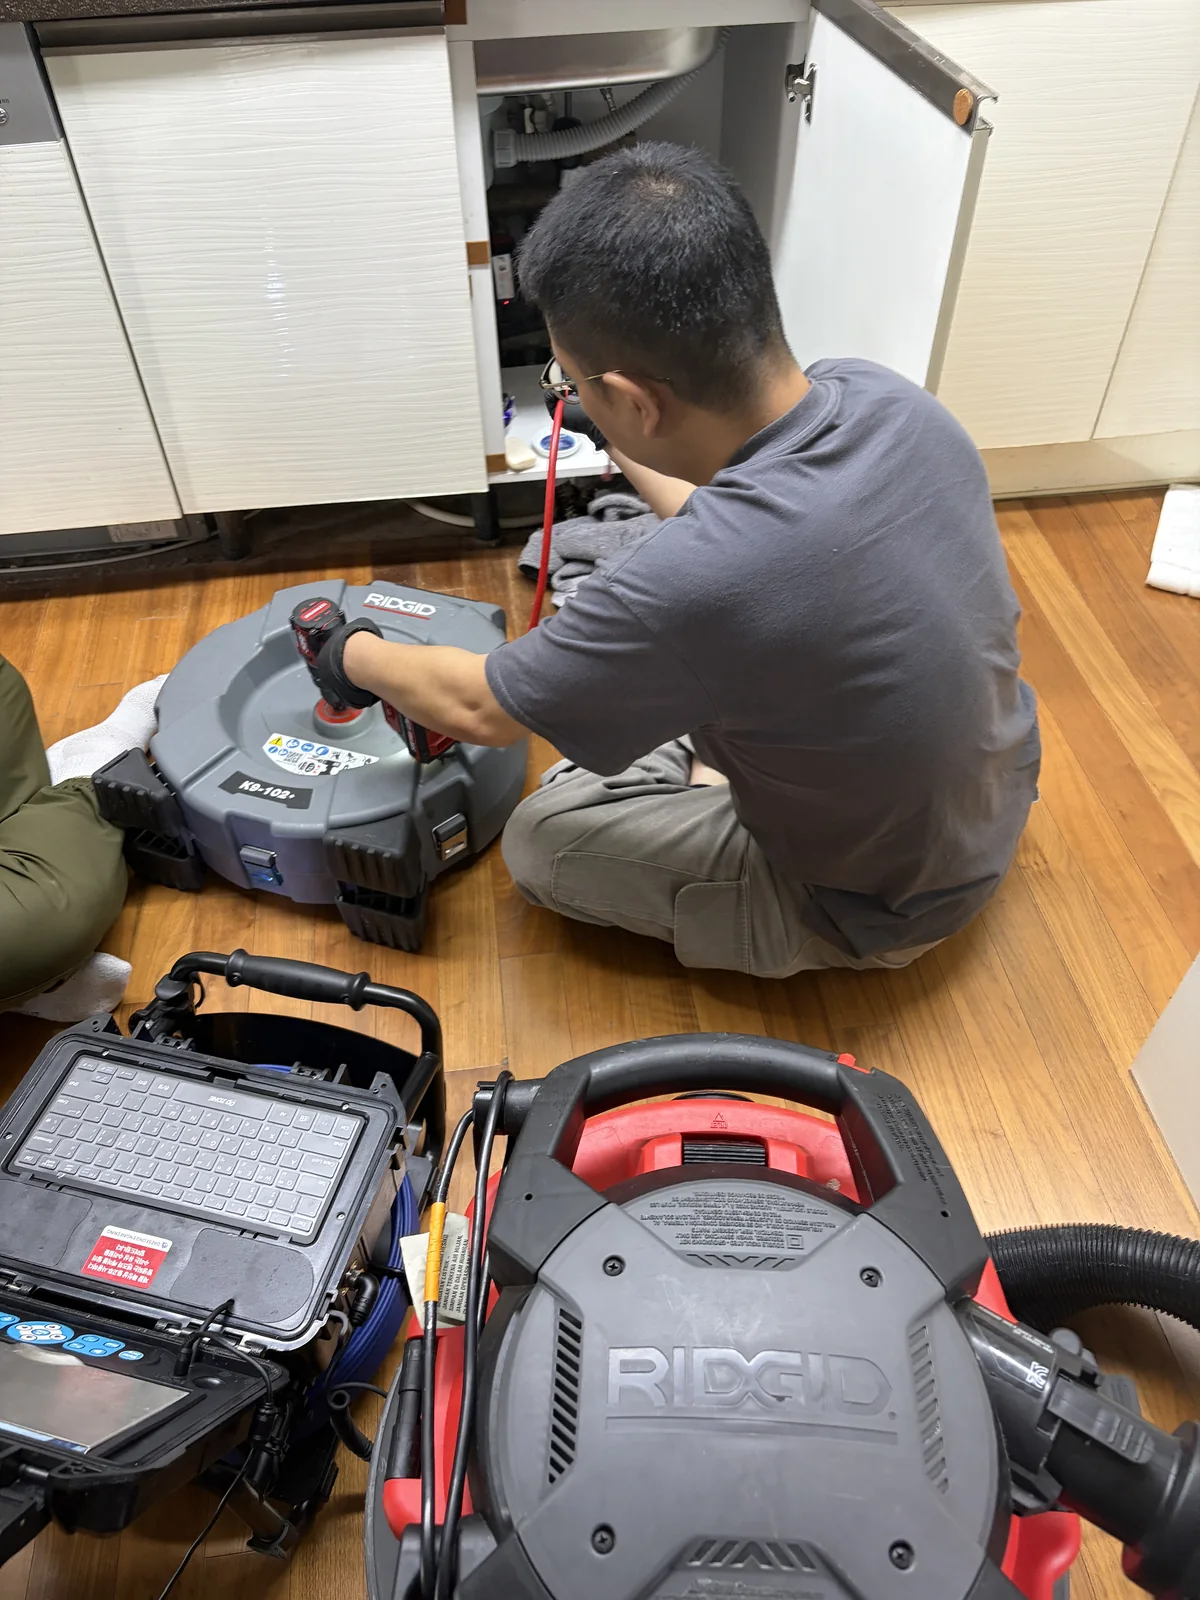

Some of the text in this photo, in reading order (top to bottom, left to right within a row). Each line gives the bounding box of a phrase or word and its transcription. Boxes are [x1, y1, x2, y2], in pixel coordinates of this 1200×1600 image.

[363, 592, 436, 616] RIDGID
[442, 1288, 450, 1309] JANGAN
[446, 1263, 455, 1286] TERKENA
[448, 1290, 456, 1311] SIMPAN
[455, 1290, 464, 1313] JANGAN
[606, 1346, 893, 1416] RIDGID
